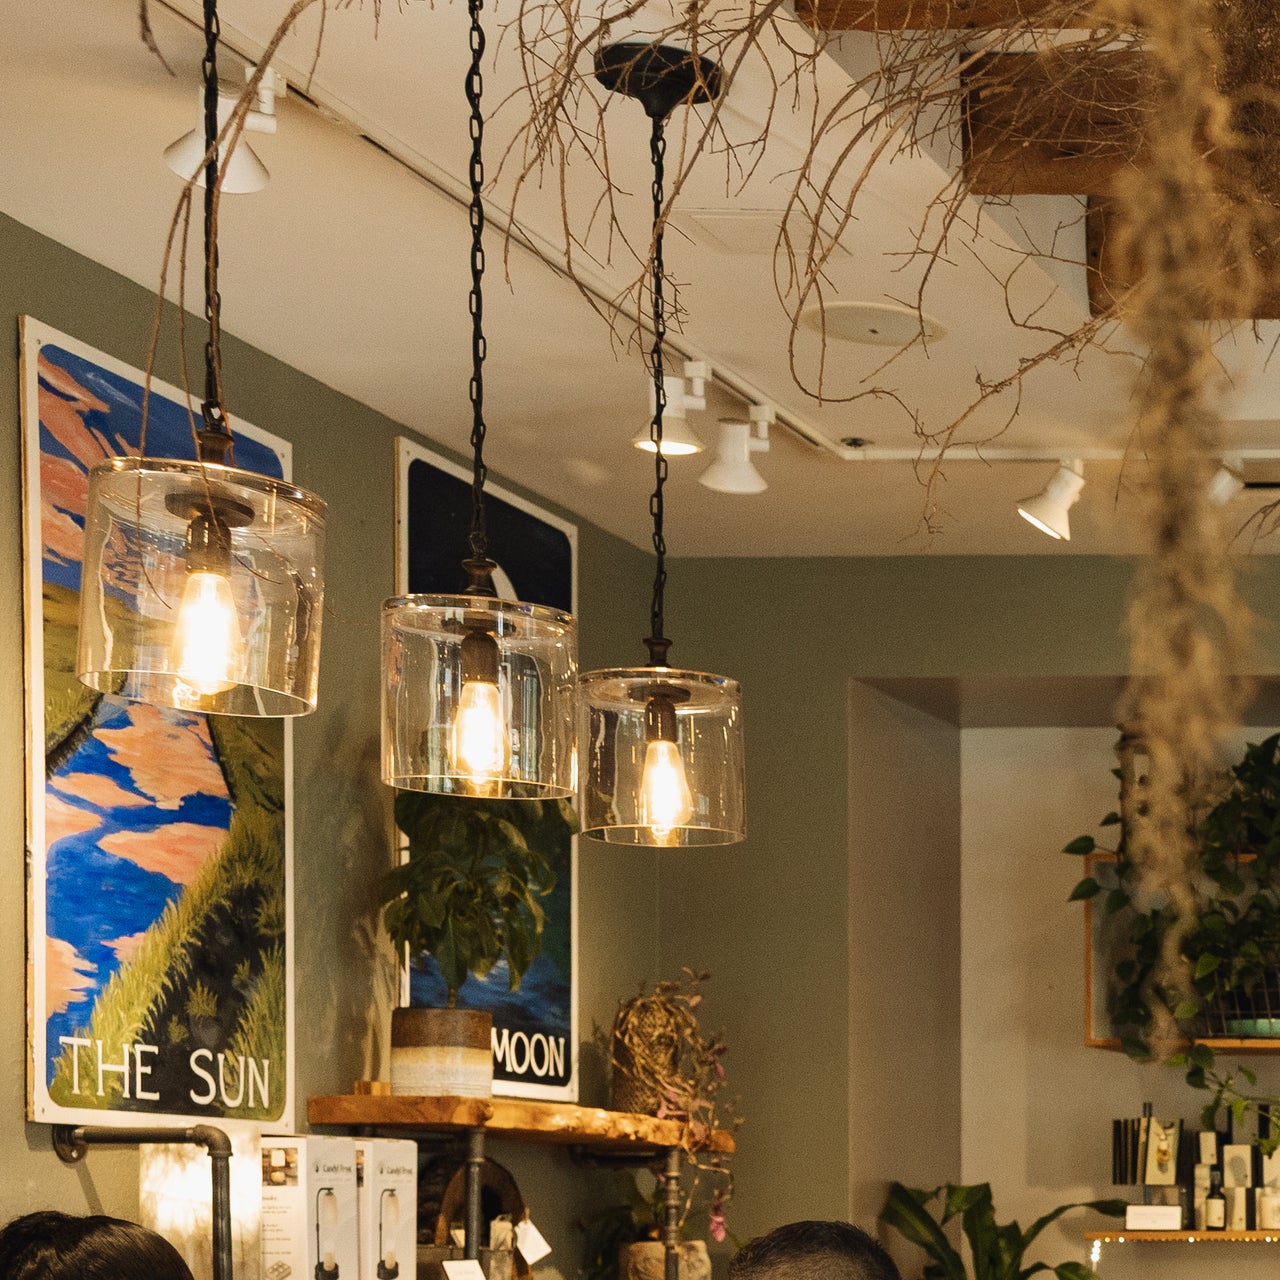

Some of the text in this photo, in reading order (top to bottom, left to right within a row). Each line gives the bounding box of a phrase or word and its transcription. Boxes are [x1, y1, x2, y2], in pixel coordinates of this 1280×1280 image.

[58, 1034, 271, 1108] THE SUN
[492, 1026, 565, 1078] MOON
